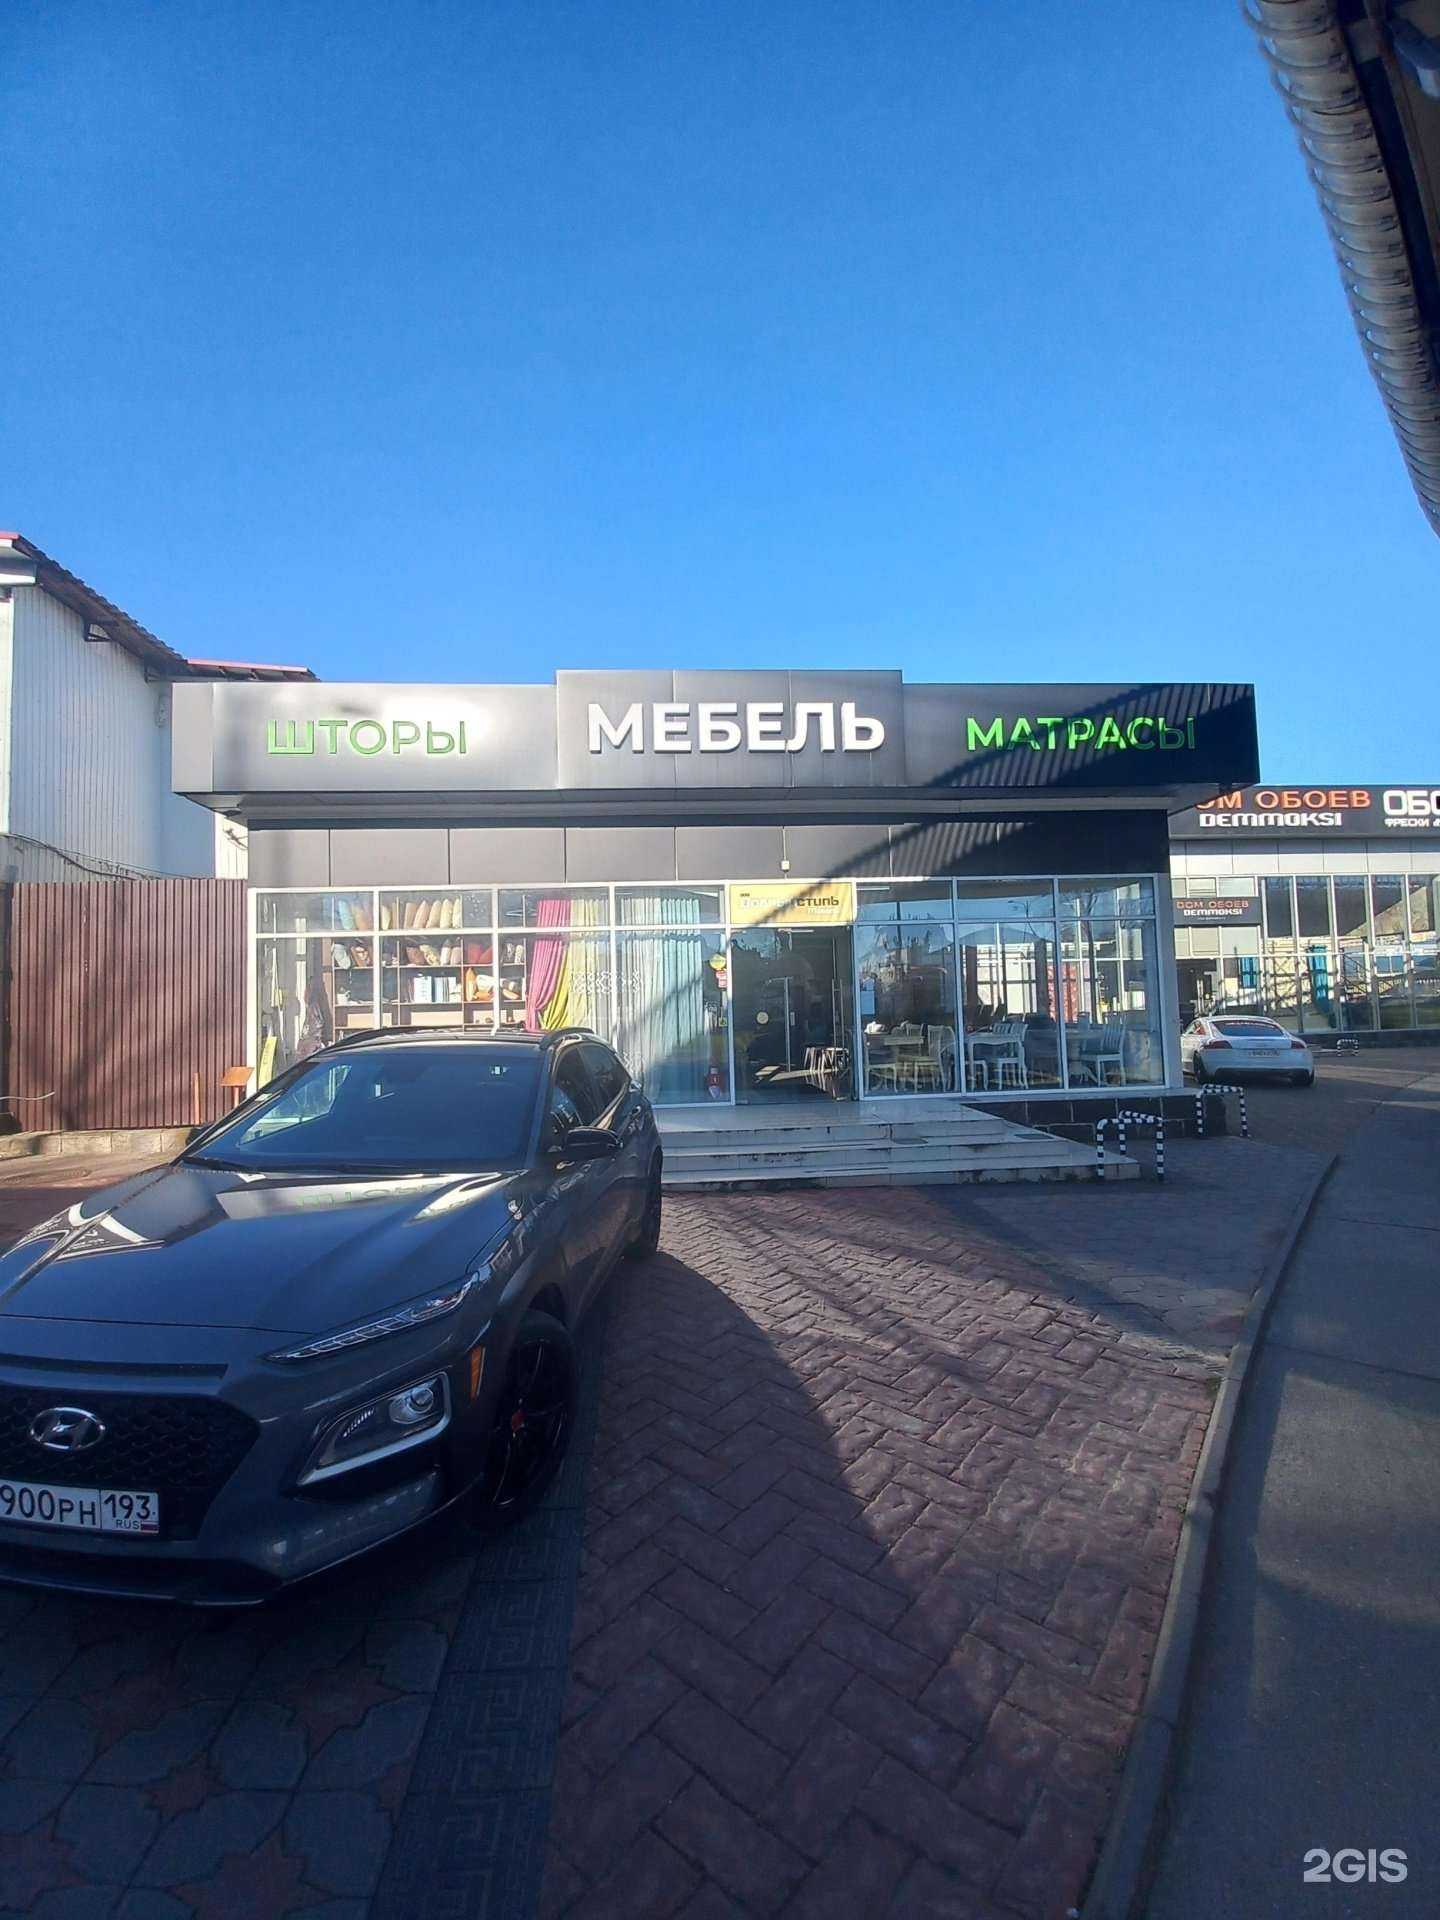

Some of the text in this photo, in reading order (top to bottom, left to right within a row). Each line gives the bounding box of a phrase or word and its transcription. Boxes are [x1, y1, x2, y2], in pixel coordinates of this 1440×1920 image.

[266, 718, 468, 755] ШТОРЫ
[588, 702, 885, 754] МЕБЕЛЬ
[966, 716, 1196, 751] МАТРАСЫ
[1255, 789, 1372, 810] ОБОЕВ
[1199, 812, 1343, 828] DEMMOKSI
[103, 1493, 152, 1520] 193
[115, 1518, 141, 1530] RUS
